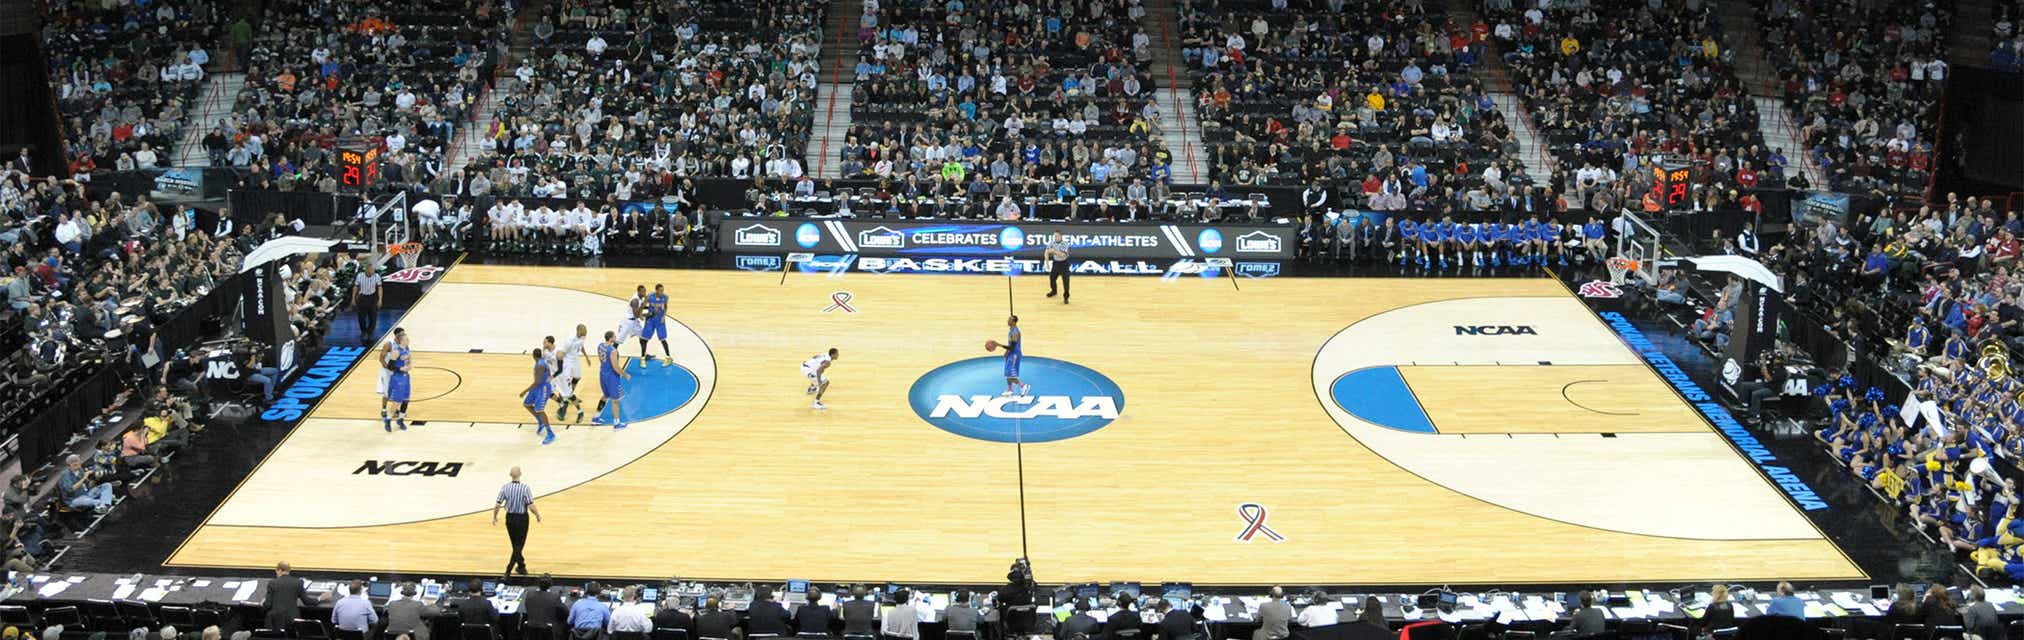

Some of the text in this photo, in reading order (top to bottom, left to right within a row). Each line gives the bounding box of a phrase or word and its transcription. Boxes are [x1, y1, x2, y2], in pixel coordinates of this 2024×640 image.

[343, 163, 361, 186] 29
[1669, 182, 1688, 204] 29
[912, 232, 997, 245] CELEBRATES
[857, 257, 1164, 274] BASKETALL
[1453, 325, 1538, 336] NCAA
[260, 346, 368, 422] SPOKANE
[929, 394, 1120, 420] NCAA
[1643, 351, 1712, 401] VETERANS
[1695, 403, 1777, 464] MEMORIAL
[1761, 465, 1829, 511] ARENA
[352, 460, 464, 477] NCAA
